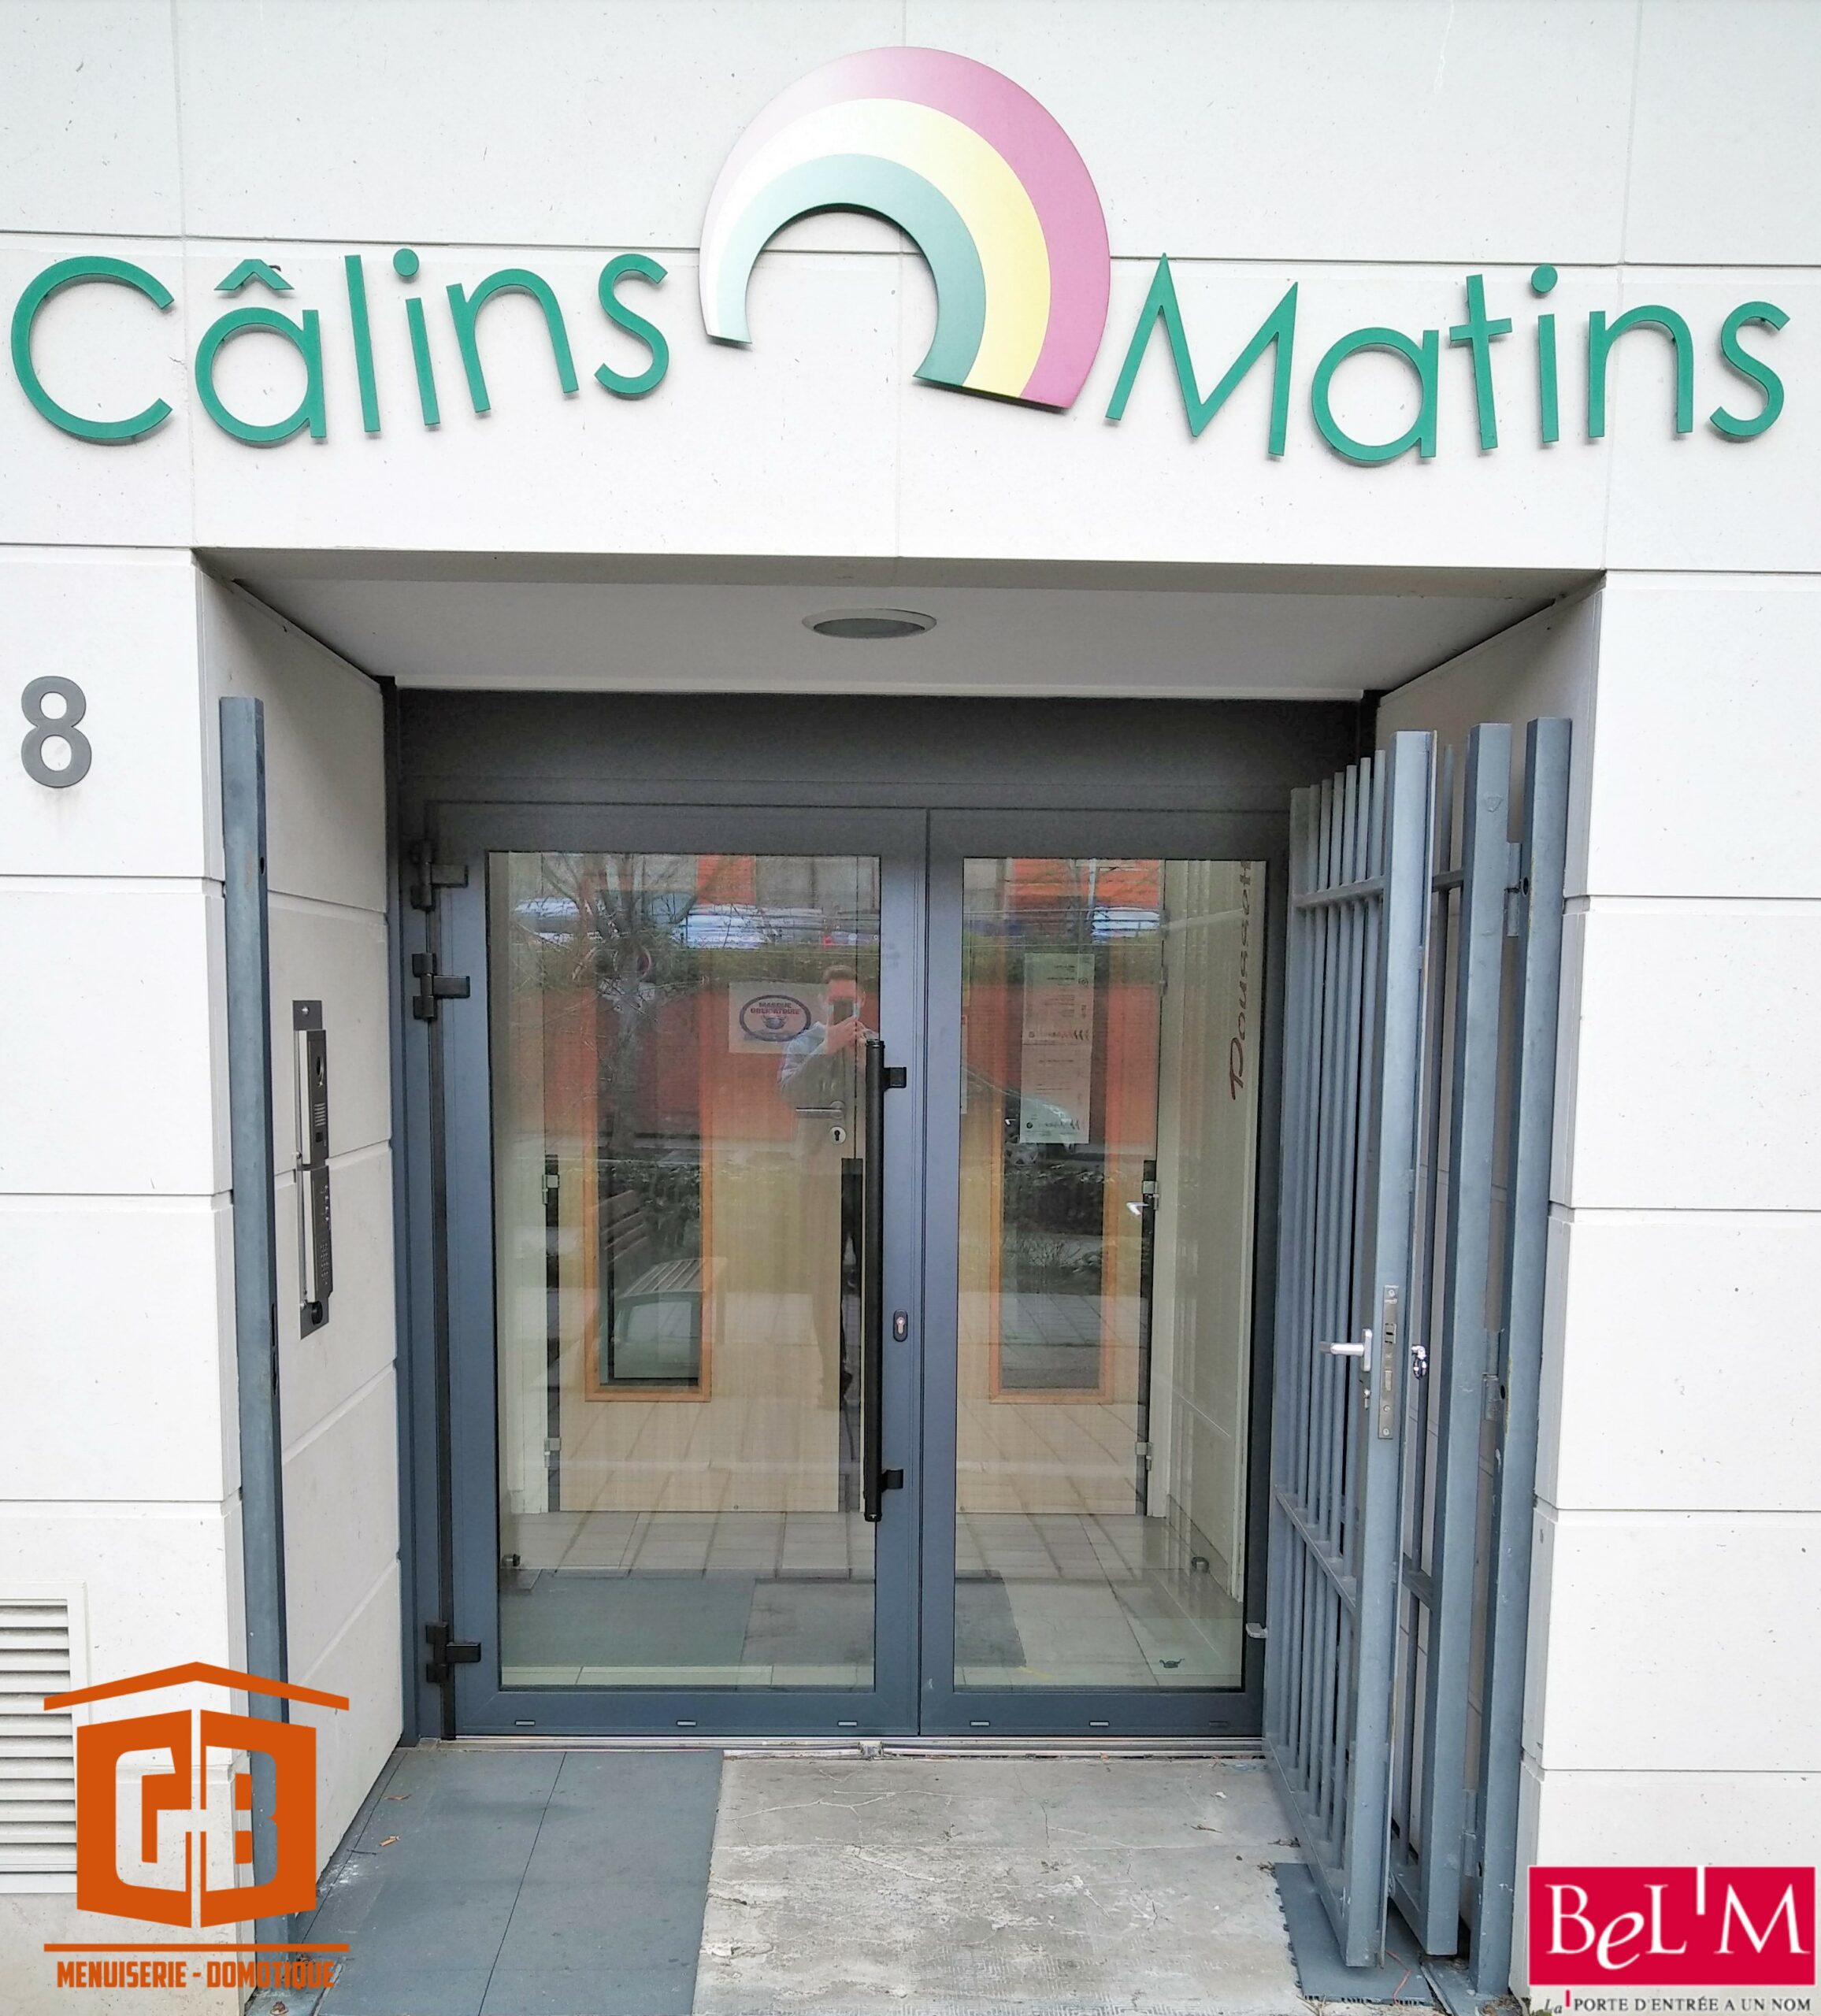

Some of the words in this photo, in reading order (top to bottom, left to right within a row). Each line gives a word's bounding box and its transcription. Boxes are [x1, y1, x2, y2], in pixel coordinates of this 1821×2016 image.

[10, 249, 669, 448] Câlins
[1107, 253, 1790, 462] Matins
[21, 676, 92, 789] 8
